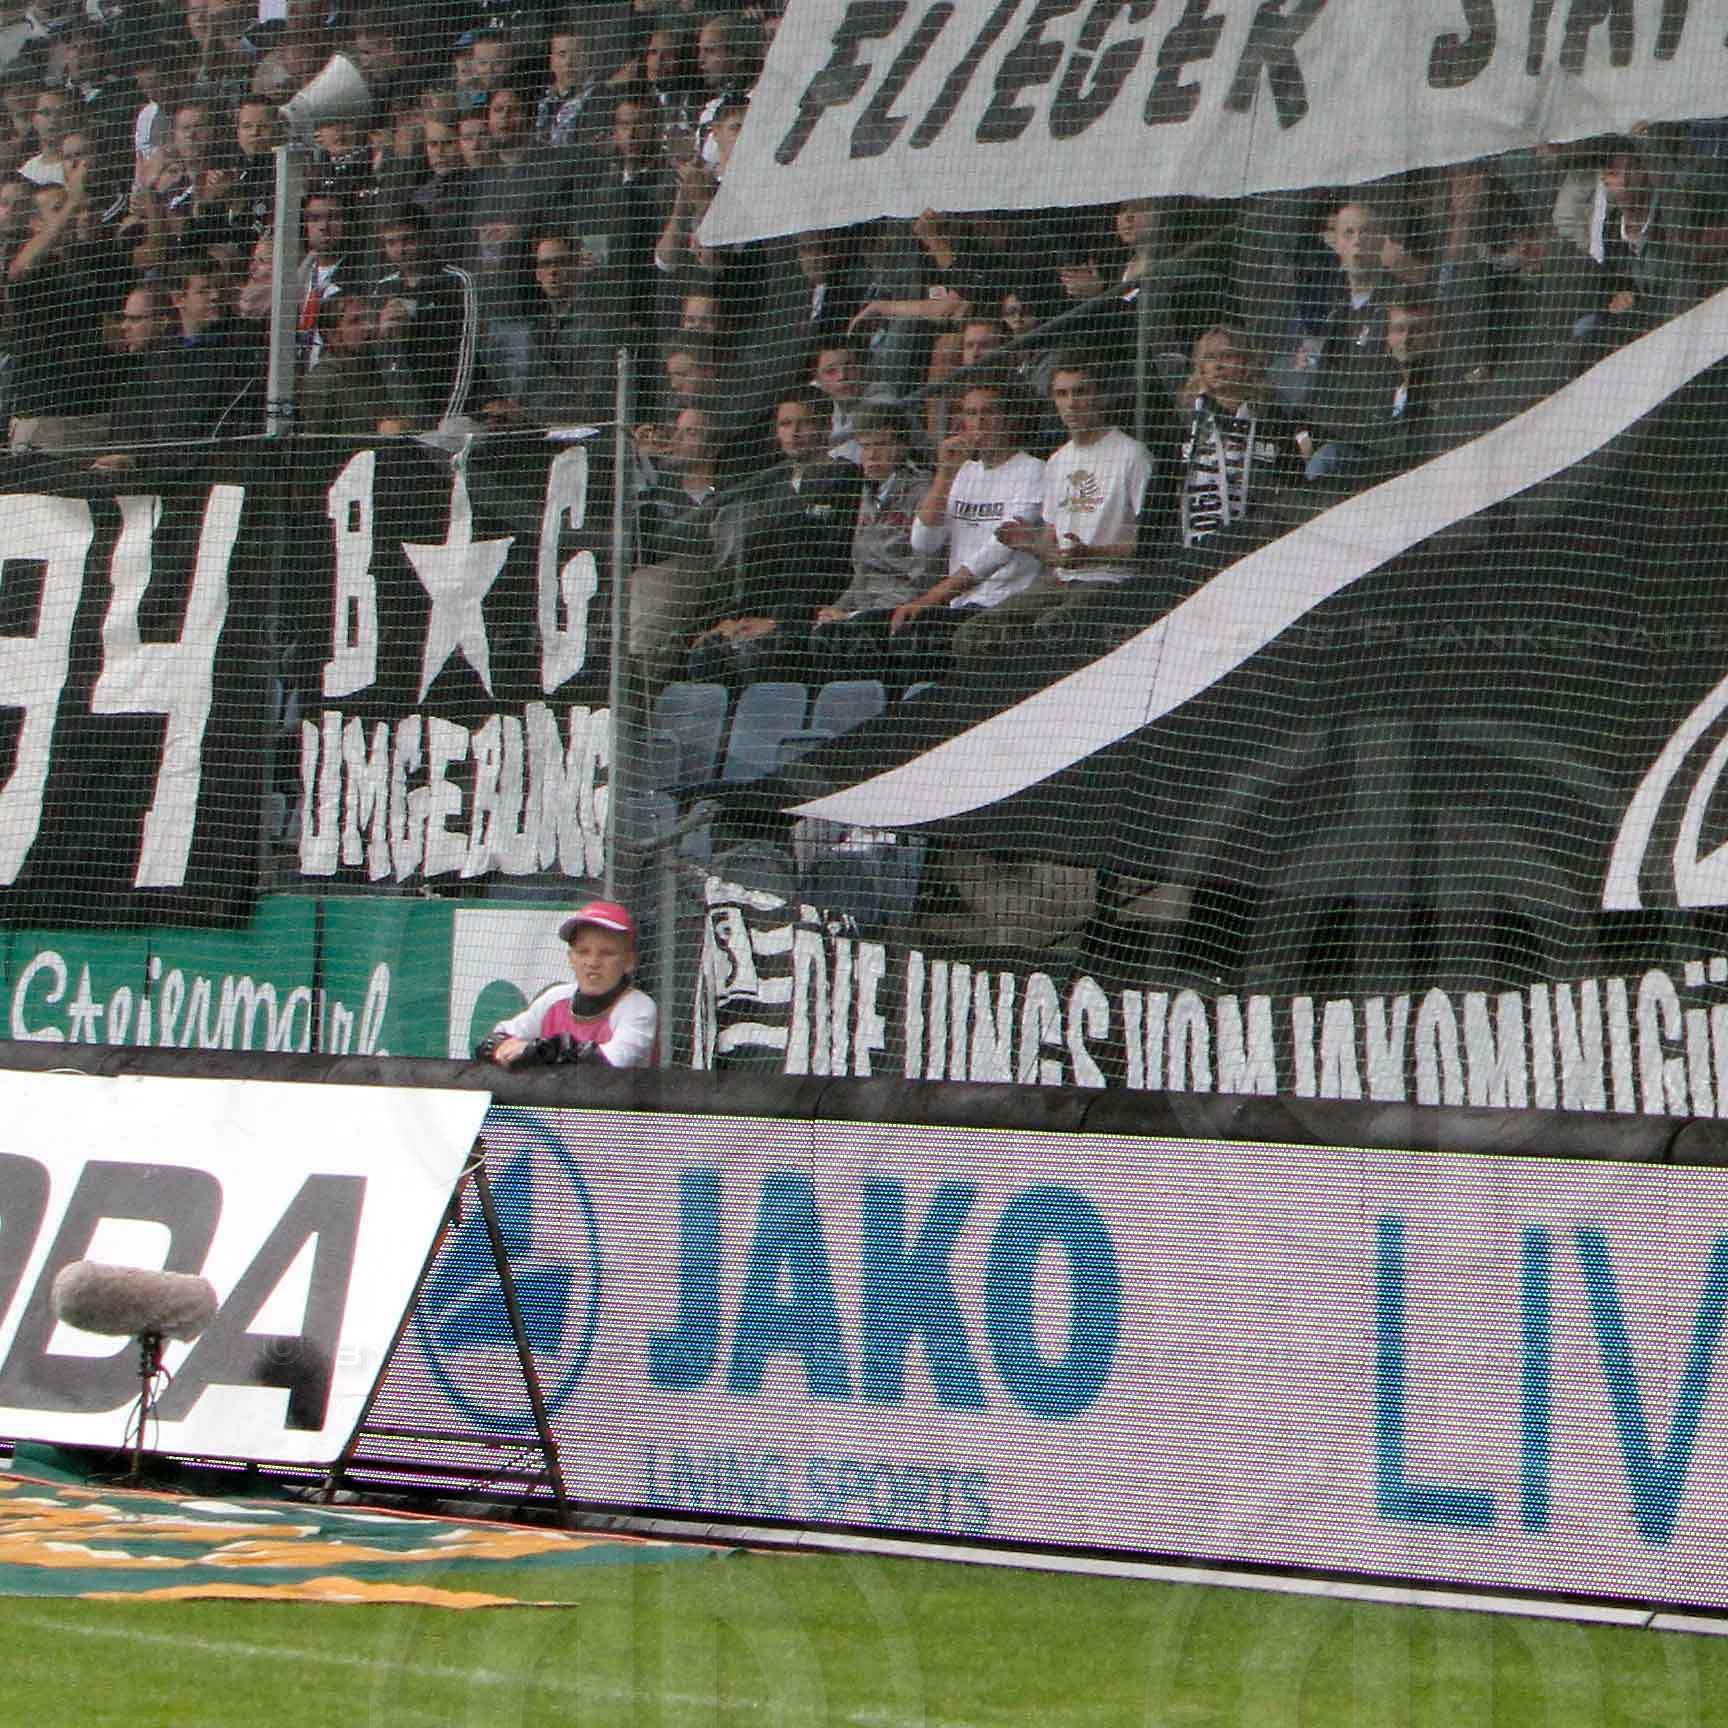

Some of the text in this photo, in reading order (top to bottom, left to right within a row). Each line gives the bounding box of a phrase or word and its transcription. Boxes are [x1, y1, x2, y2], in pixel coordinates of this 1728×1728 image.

[648, 1165, 1124, 1421] JAKO
[646, 1440, 992, 1535] LIVING SPORTS
